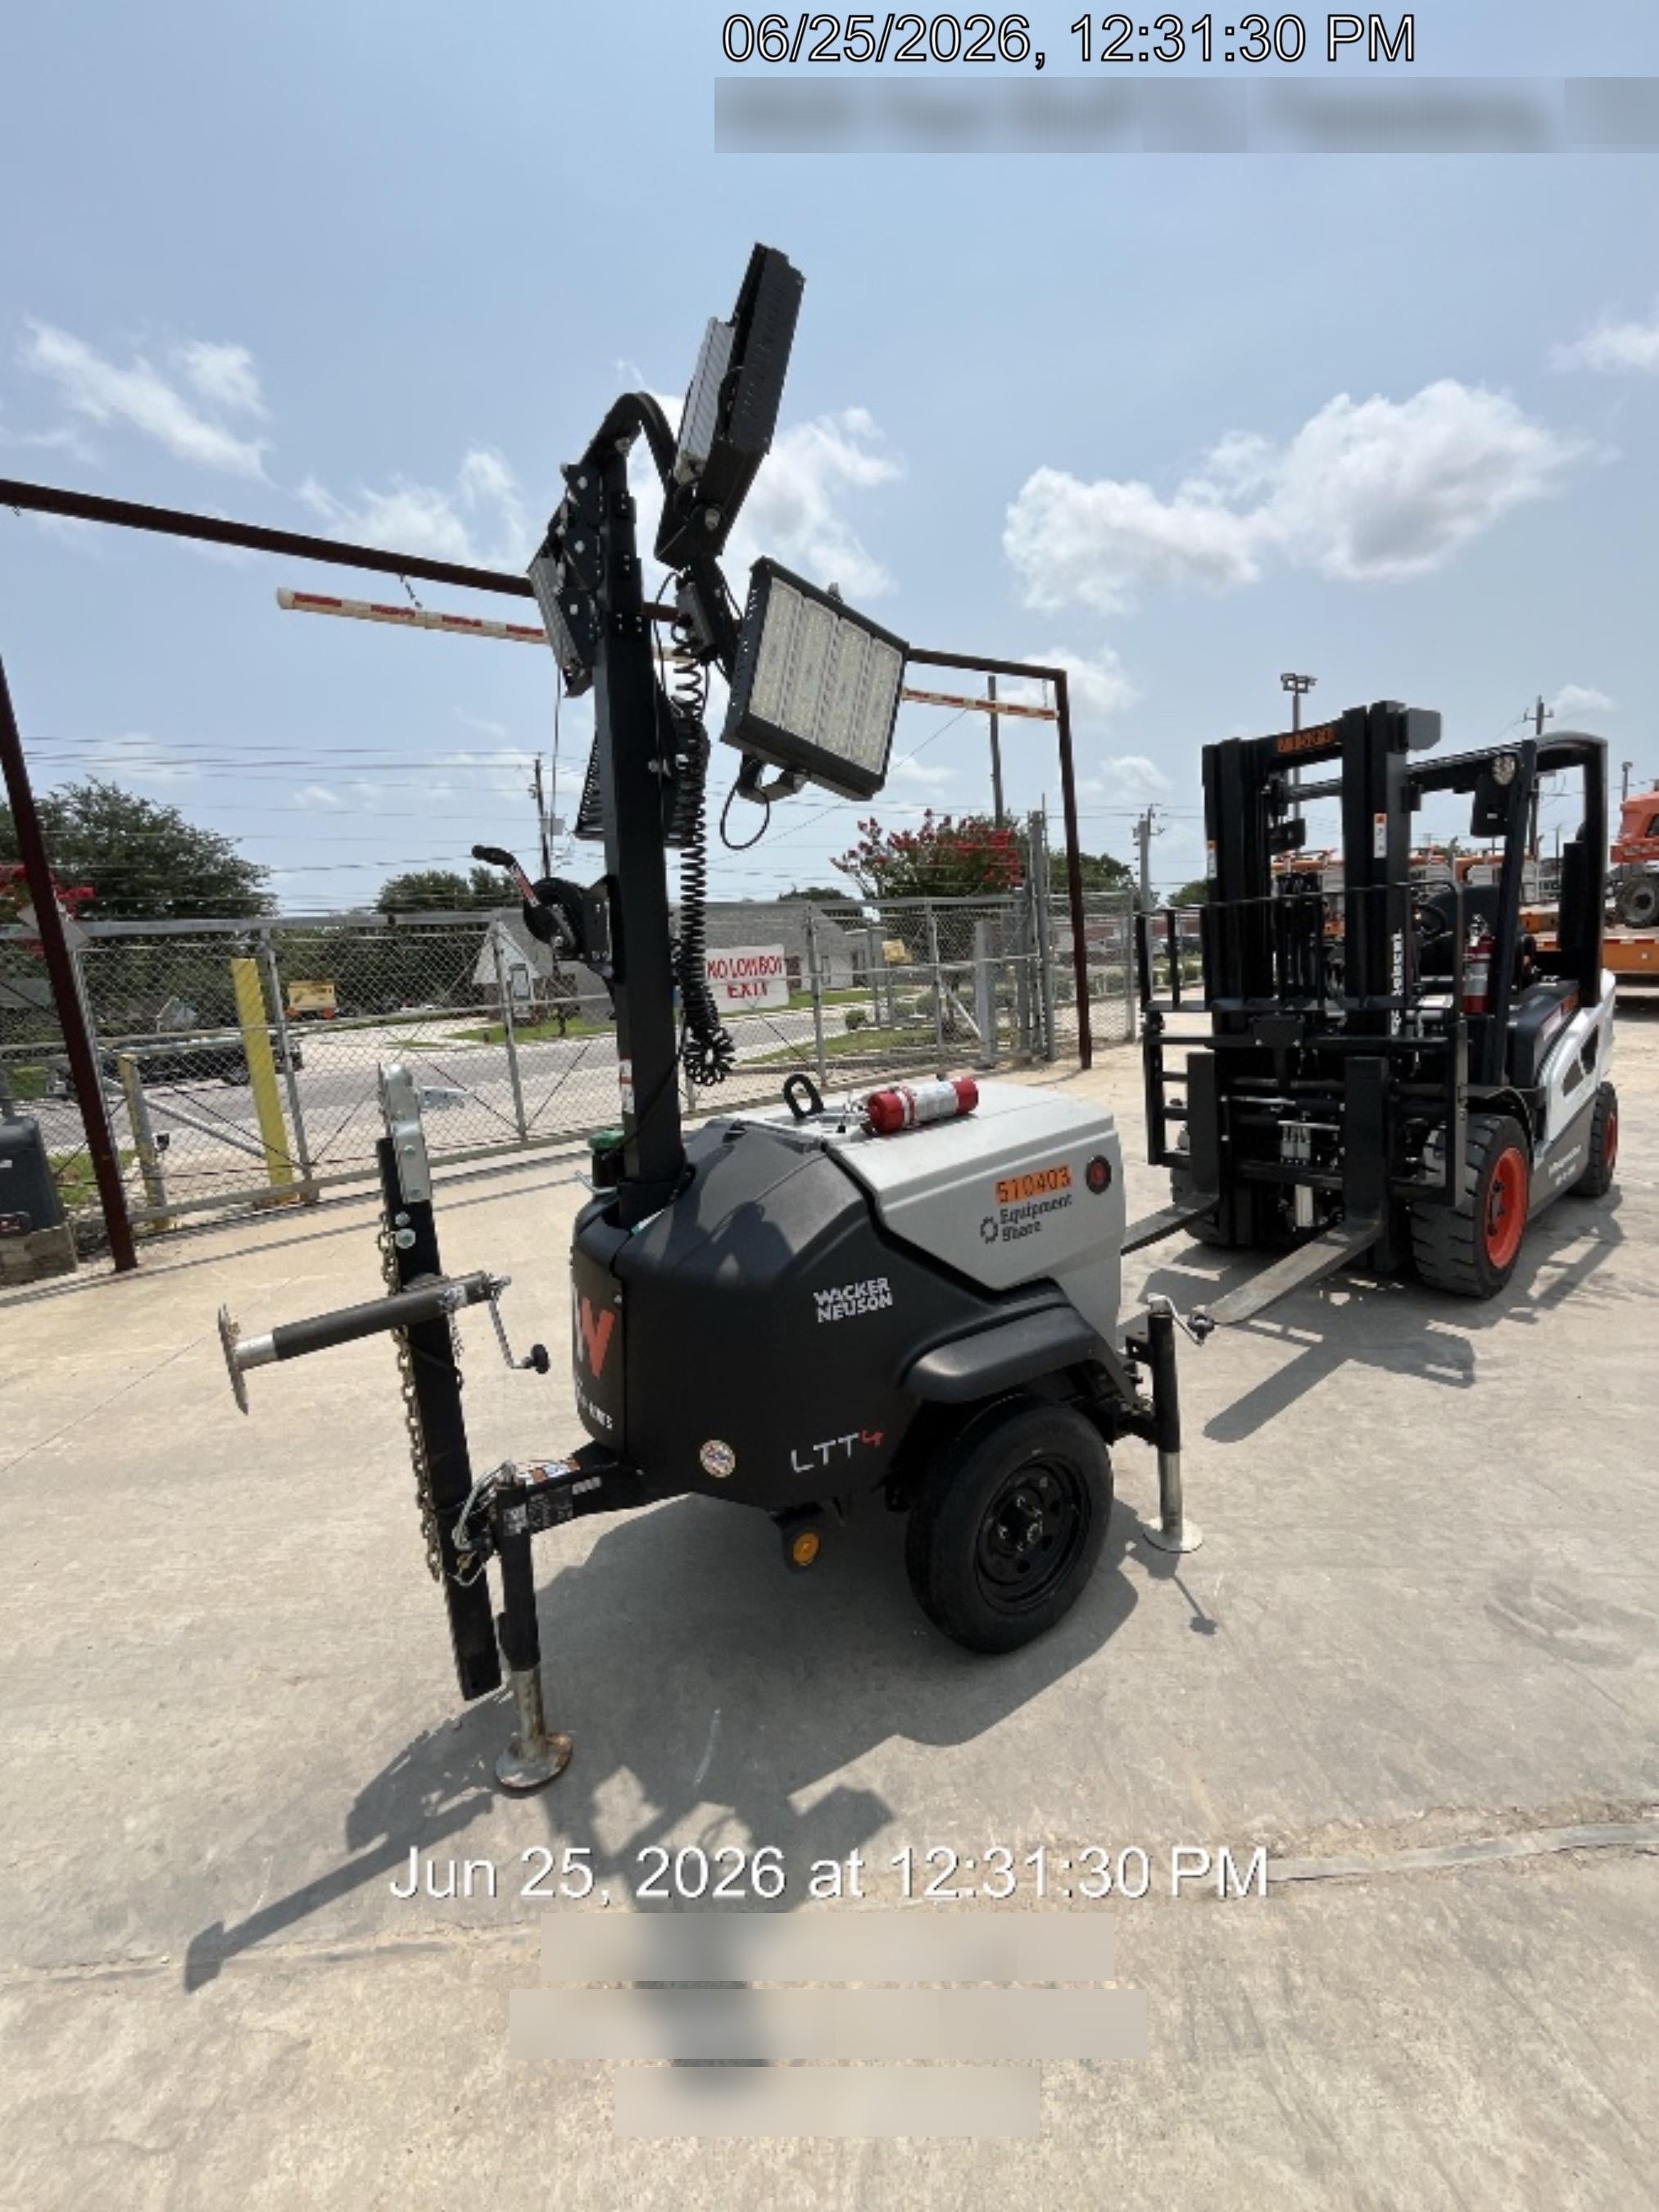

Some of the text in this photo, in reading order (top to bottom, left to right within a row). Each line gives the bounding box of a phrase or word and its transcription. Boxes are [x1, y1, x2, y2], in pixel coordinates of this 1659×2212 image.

[707, 958, 728, 979] NO
[727, 982, 768, 999] EXIT
[999, 1194, 1072, 1225] Equipment
[813, 1277, 891, 1306] WACKER
[817, 1292, 894, 1323] NEUSON
